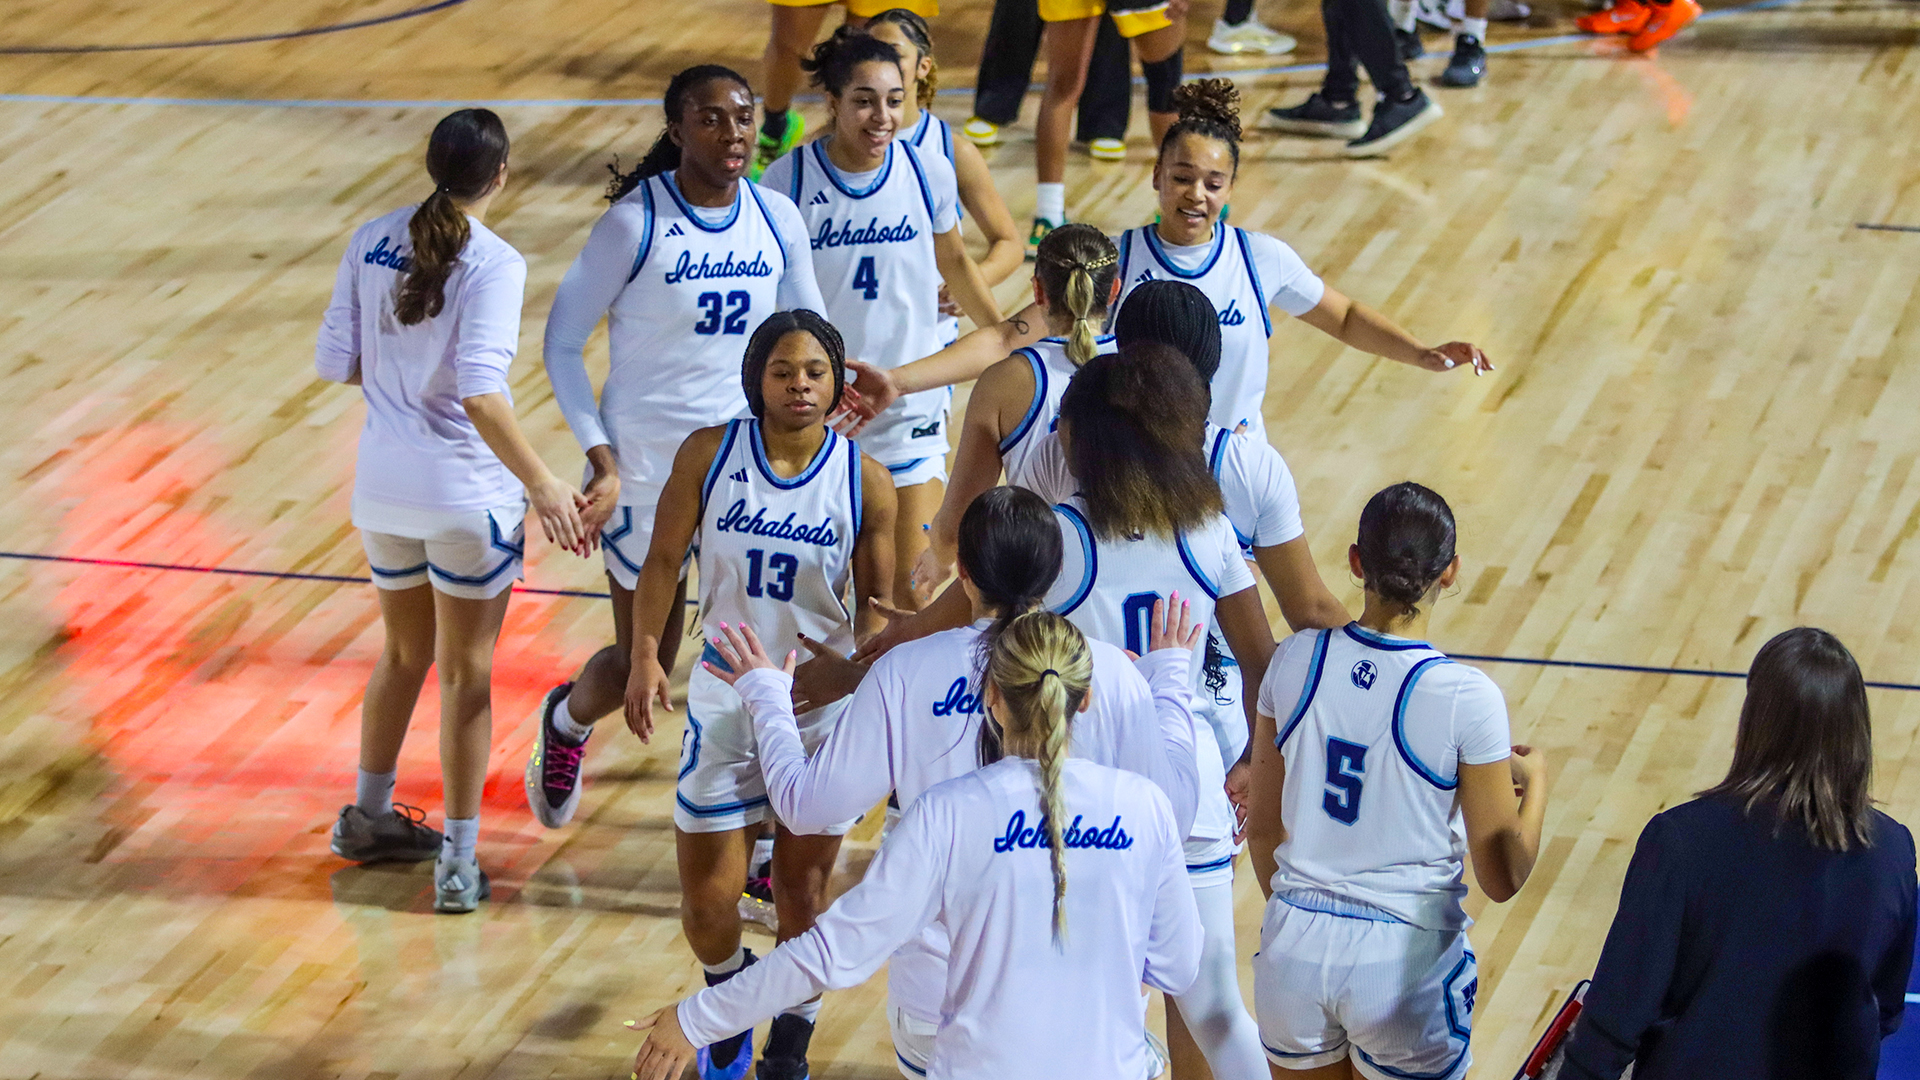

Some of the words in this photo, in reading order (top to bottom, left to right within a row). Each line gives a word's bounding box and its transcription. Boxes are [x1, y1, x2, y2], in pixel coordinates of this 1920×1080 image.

[810, 214, 918, 250] Ichabods
[665, 250, 773, 285] Ichabods
[852, 256, 879, 301] 4
[694, 290, 751, 335] 32
[716, 498, 839, 548] Ichabods
[746, 549, 798, 603] 13
[1322, 735, 1369, 827] 5
[994, 809, 1134, 853] Ichbods
